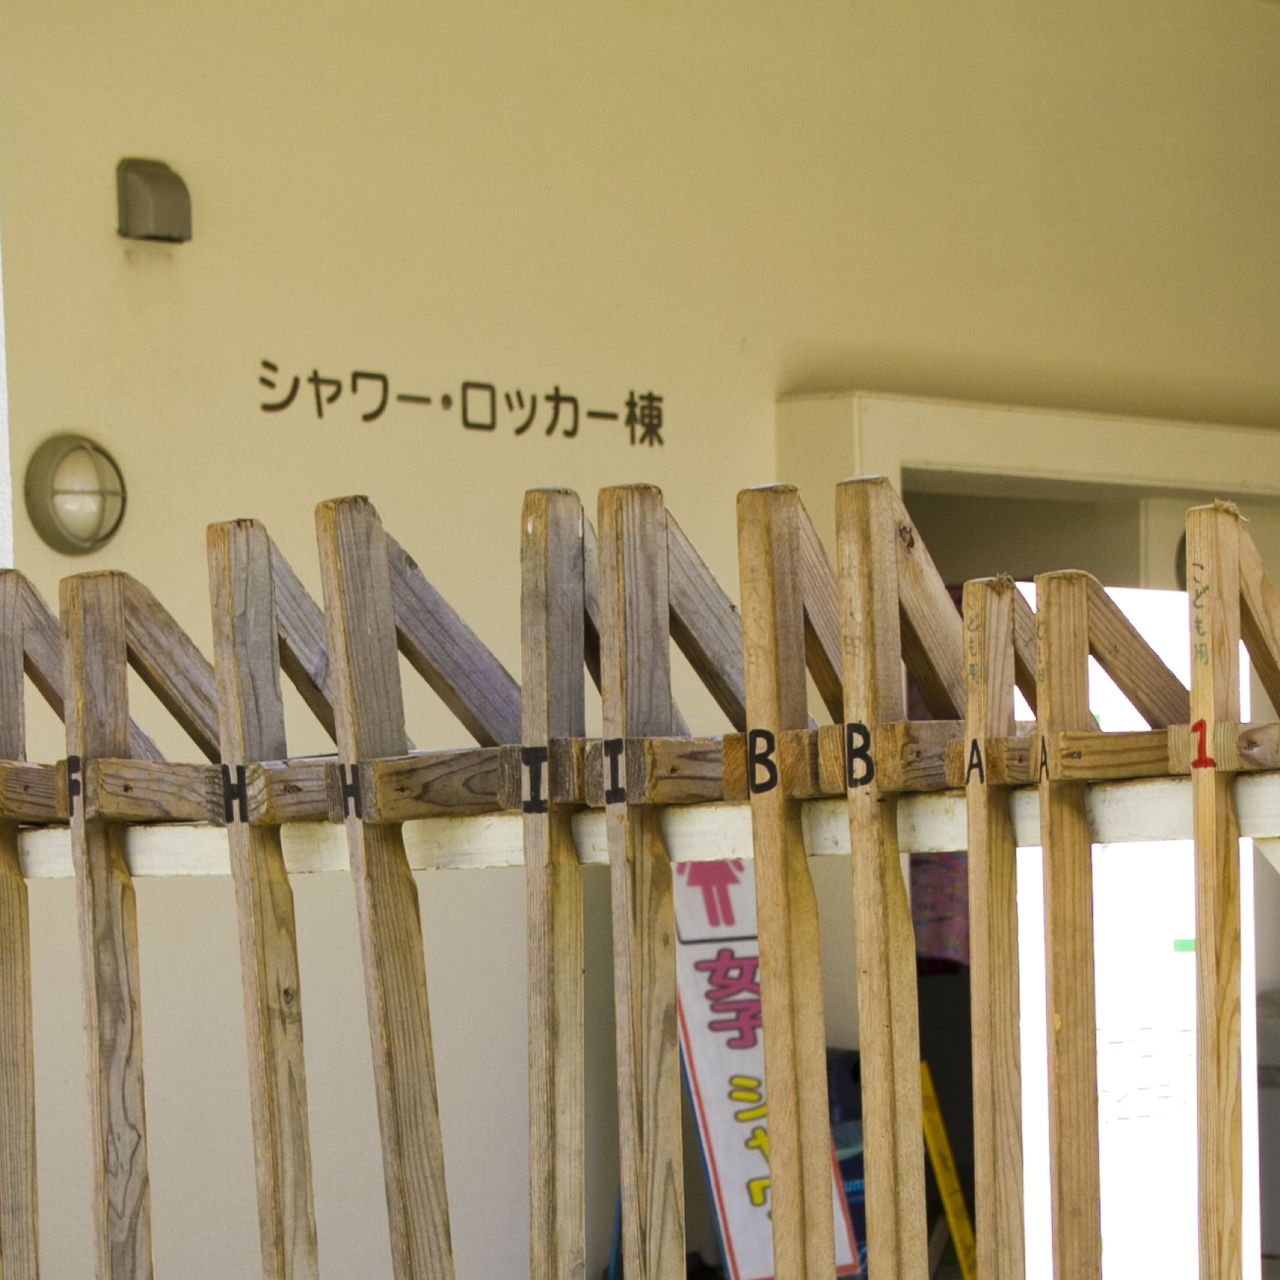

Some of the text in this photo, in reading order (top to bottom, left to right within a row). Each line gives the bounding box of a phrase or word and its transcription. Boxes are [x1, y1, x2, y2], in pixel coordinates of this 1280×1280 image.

[258, 358, 665, 448] シャワー・ロッカー棟
[604, 738, 626, 803] I
[747, 728, 778, 794] B
[846, 722, 875, 788] B
[965, 738, 984, 785] A
[1039, 736, 1049, 784] A
[1190, 719, 1216, 768] 1
[67, 755, 81, 817] F
[222, 764, 247, 823] H
[339, 764, 363, 819] H
